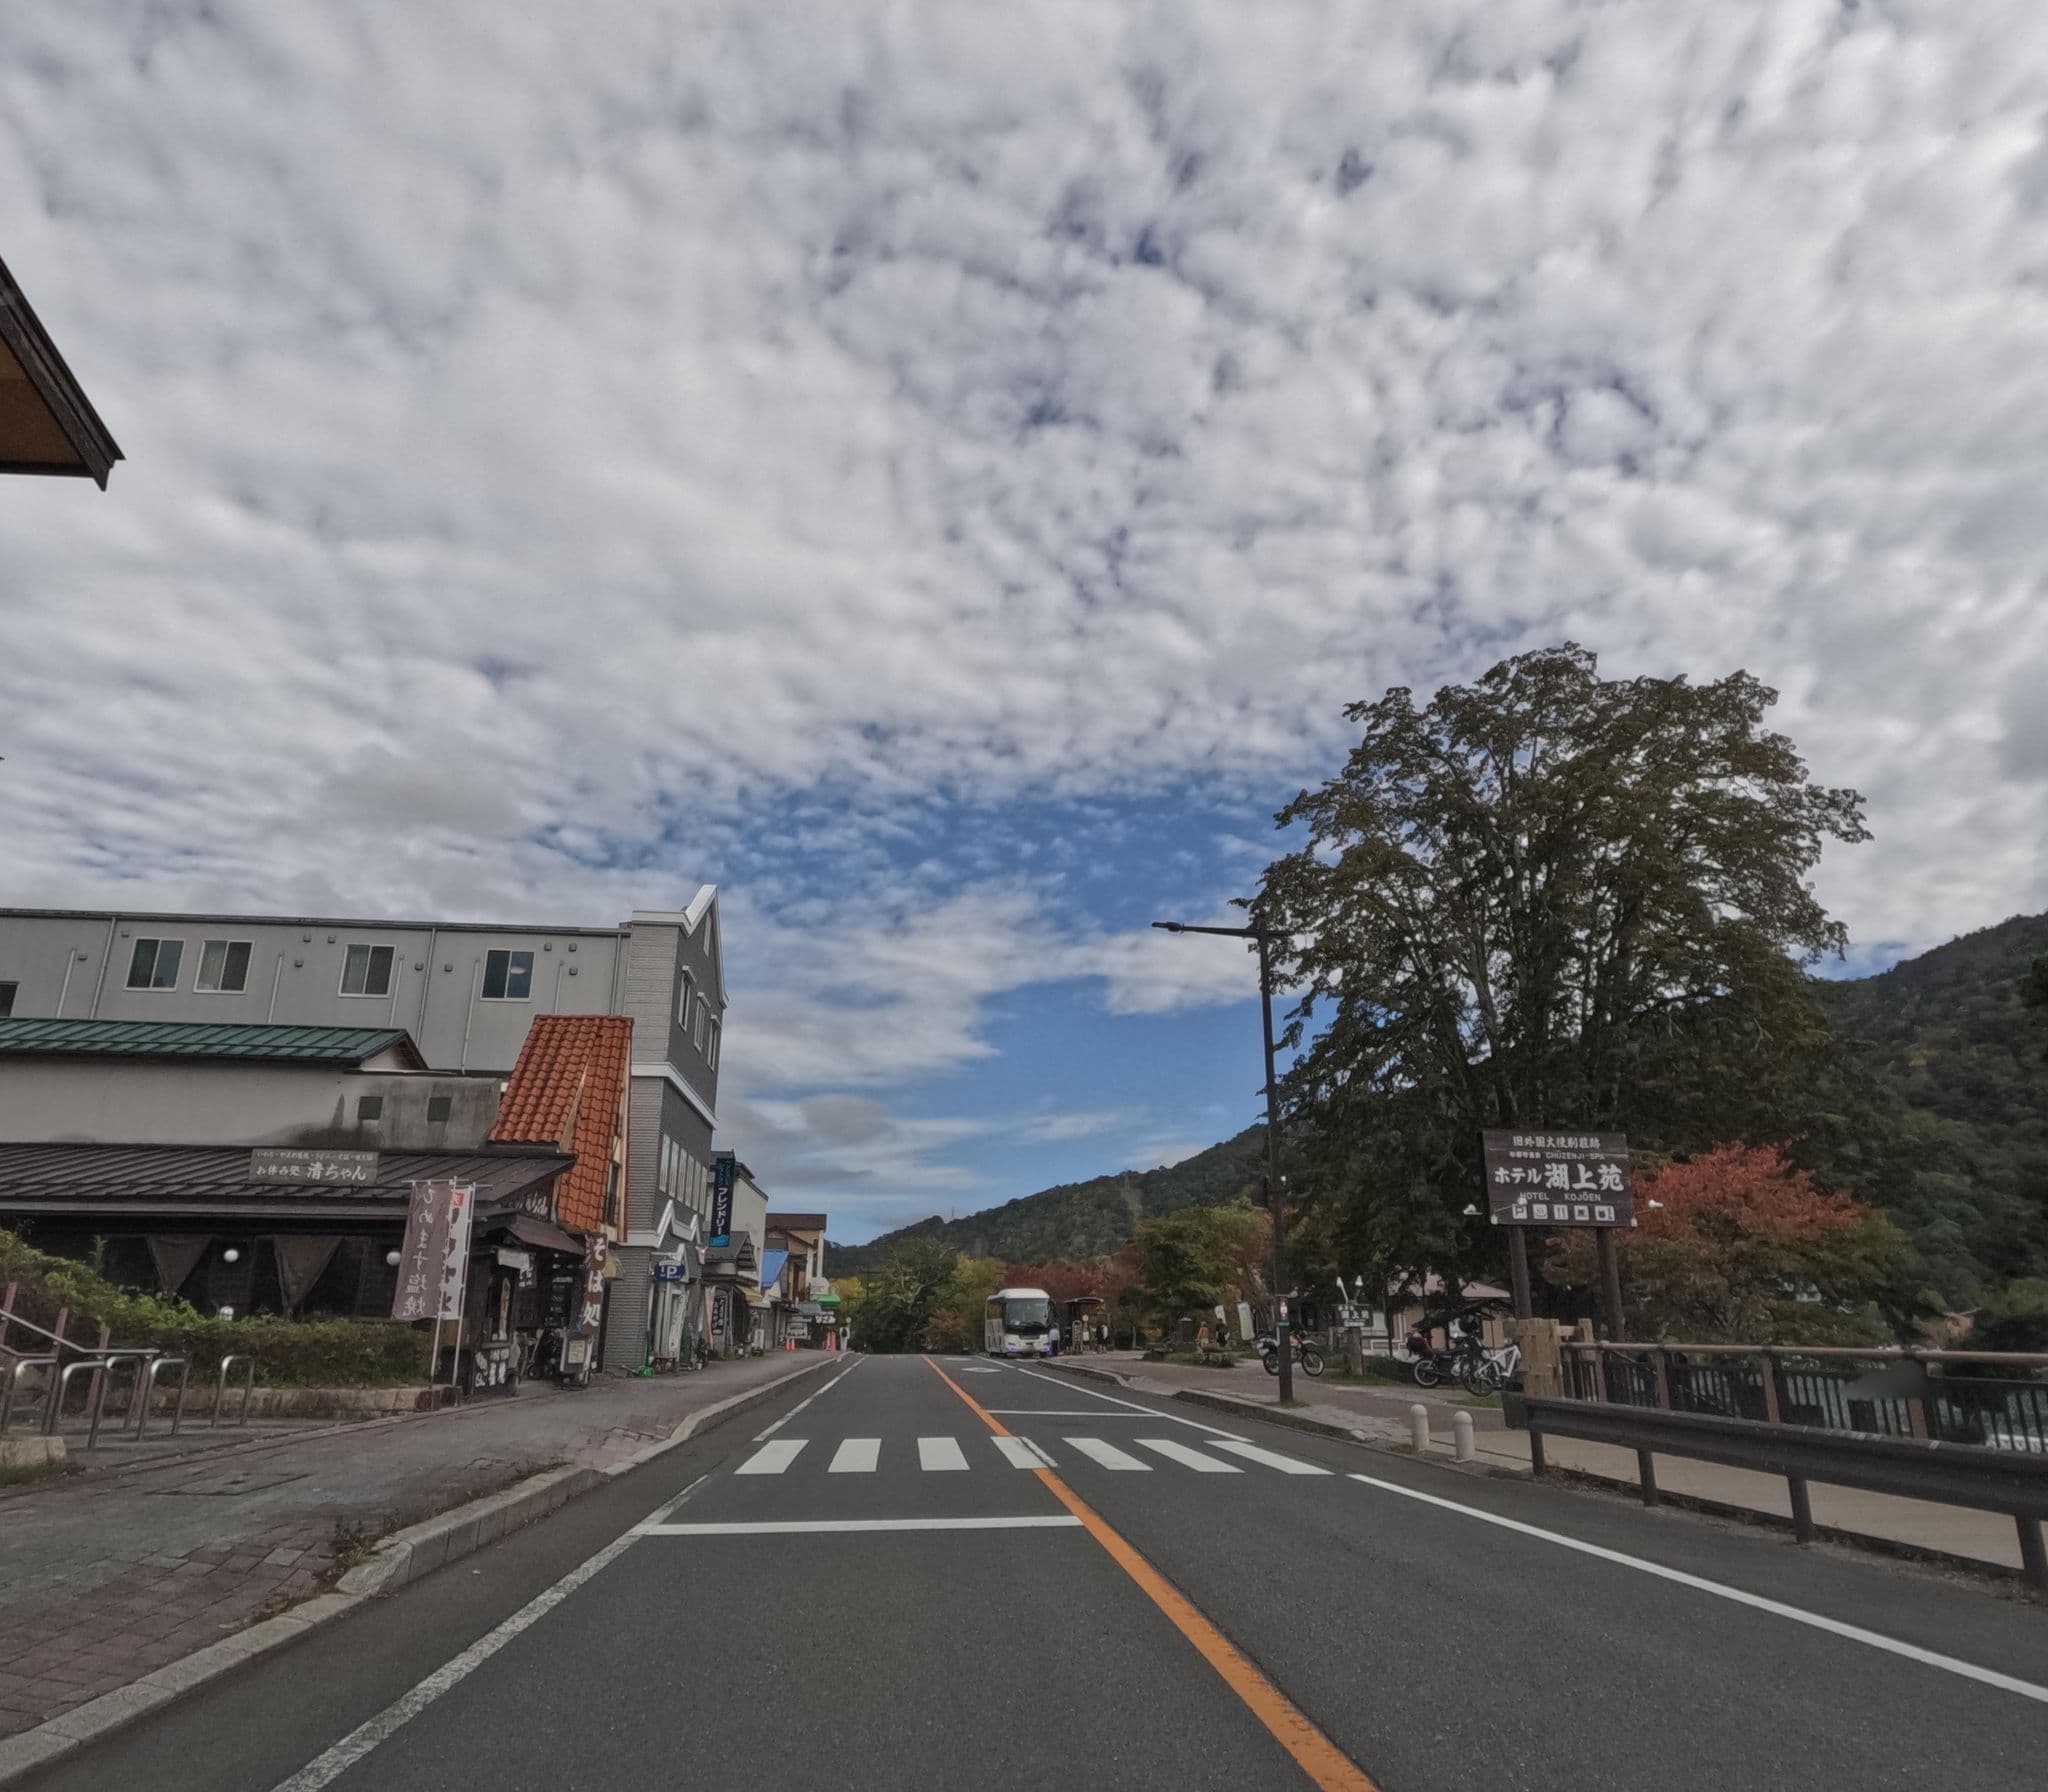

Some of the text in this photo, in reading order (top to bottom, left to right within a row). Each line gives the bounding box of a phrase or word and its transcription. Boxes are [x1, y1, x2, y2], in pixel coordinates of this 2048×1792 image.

[307, 1161, 366, 1180] 清ちゃん
[1520, 1191, 1550, 1201] HOTEL
[716, 1187, 728, 1236] フレンドリー
[666, 1265, 678, 1279] P
